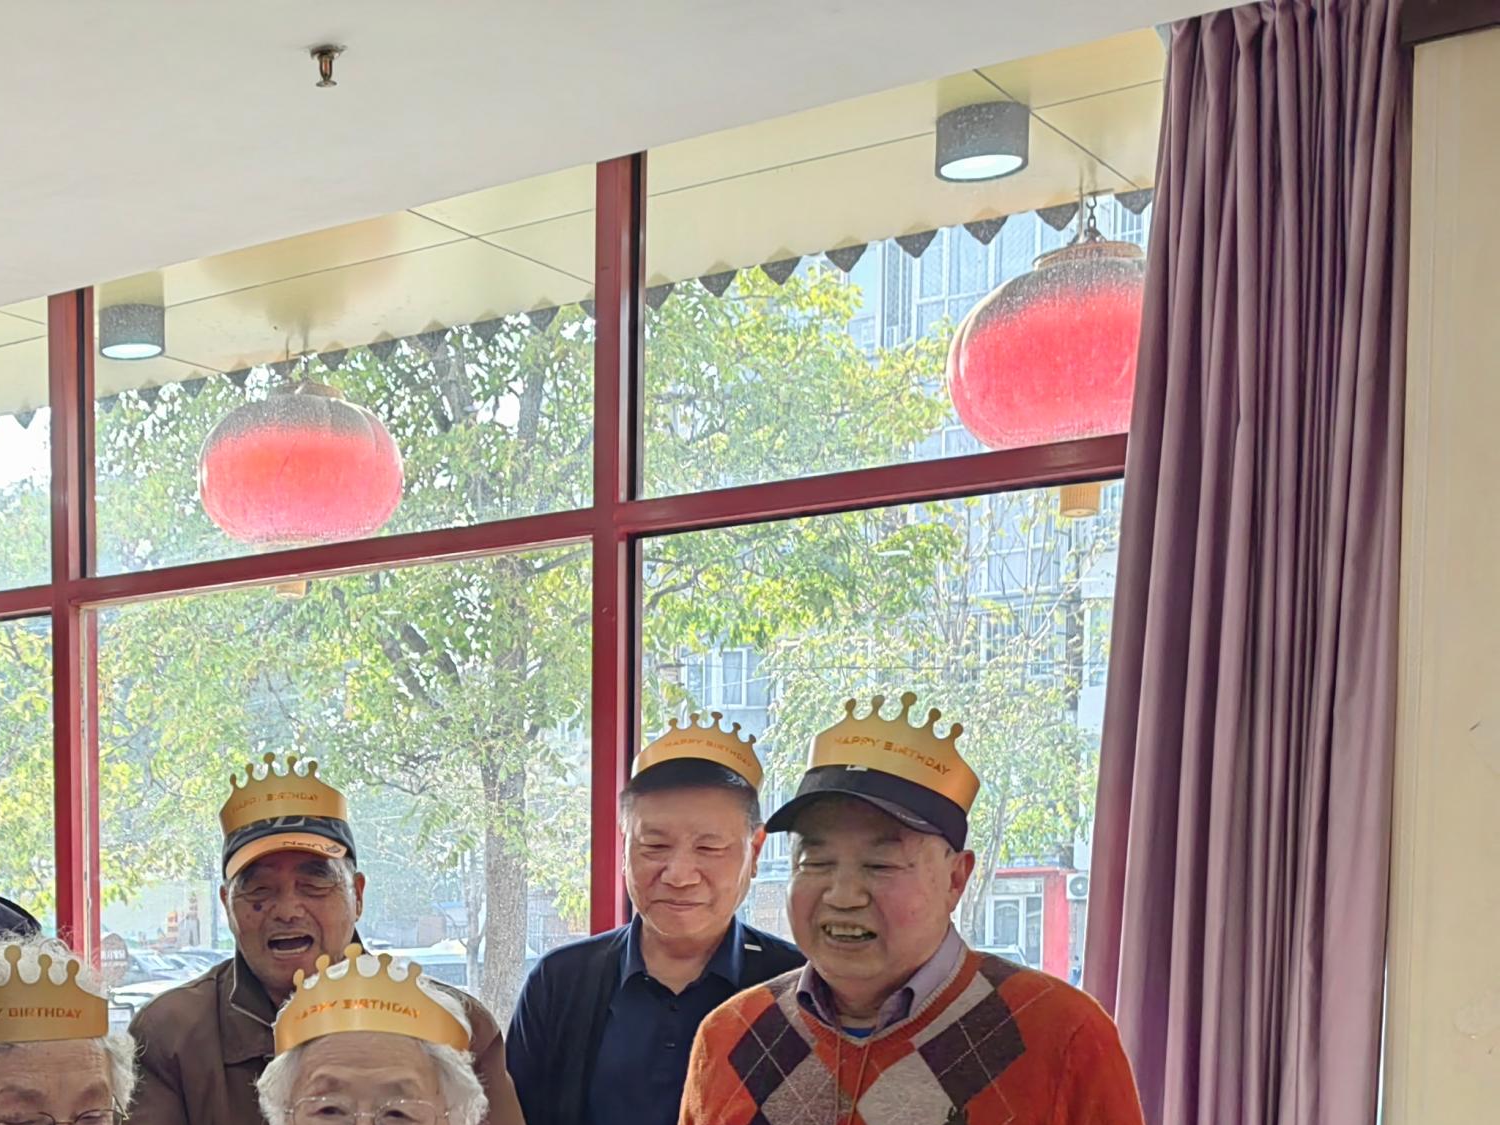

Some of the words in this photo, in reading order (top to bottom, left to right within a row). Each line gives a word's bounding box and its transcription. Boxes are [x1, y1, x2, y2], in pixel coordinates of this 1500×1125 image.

[834, 735, 881, 748] HAPPY
[883, 741, 952, 776] BIRTHDAY
[8, 1006, 83, 1020] BIRTHDAY
[343, 998, 420, 1019] BIRTHDAY
